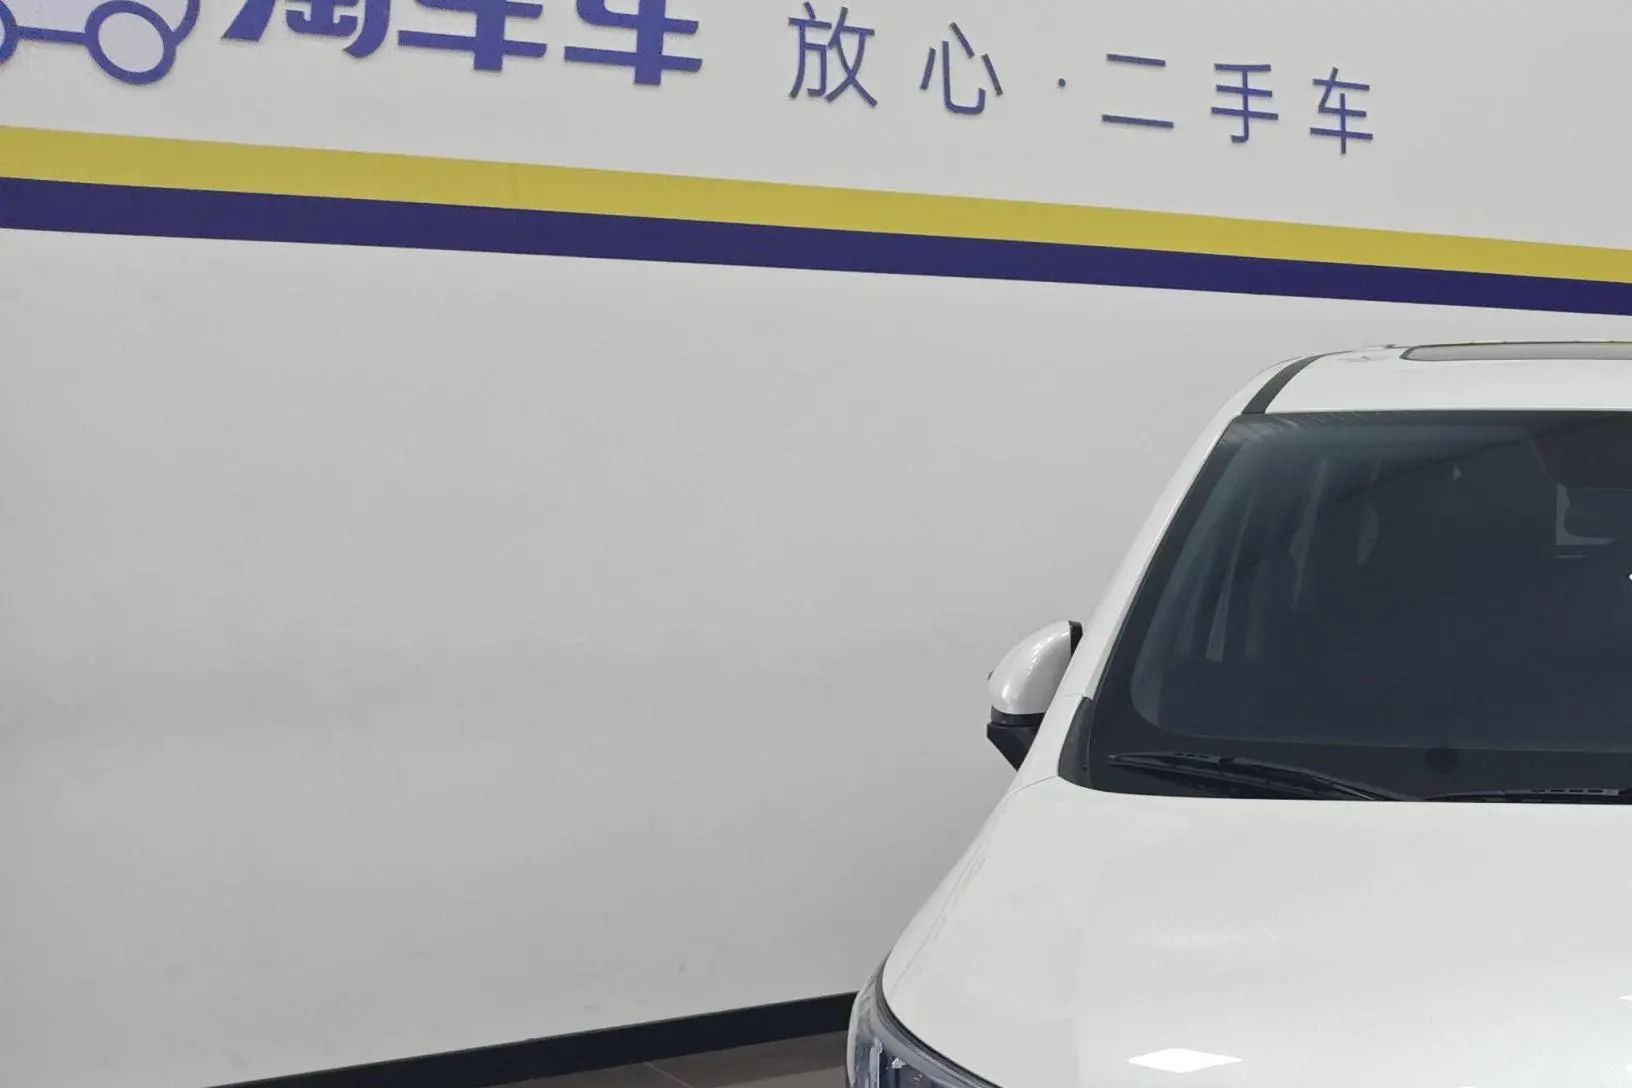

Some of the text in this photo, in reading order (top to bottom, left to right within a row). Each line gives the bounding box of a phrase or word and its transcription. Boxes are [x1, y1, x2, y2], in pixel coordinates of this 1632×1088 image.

[787, 1, 1374, 155] 放心·二手车
